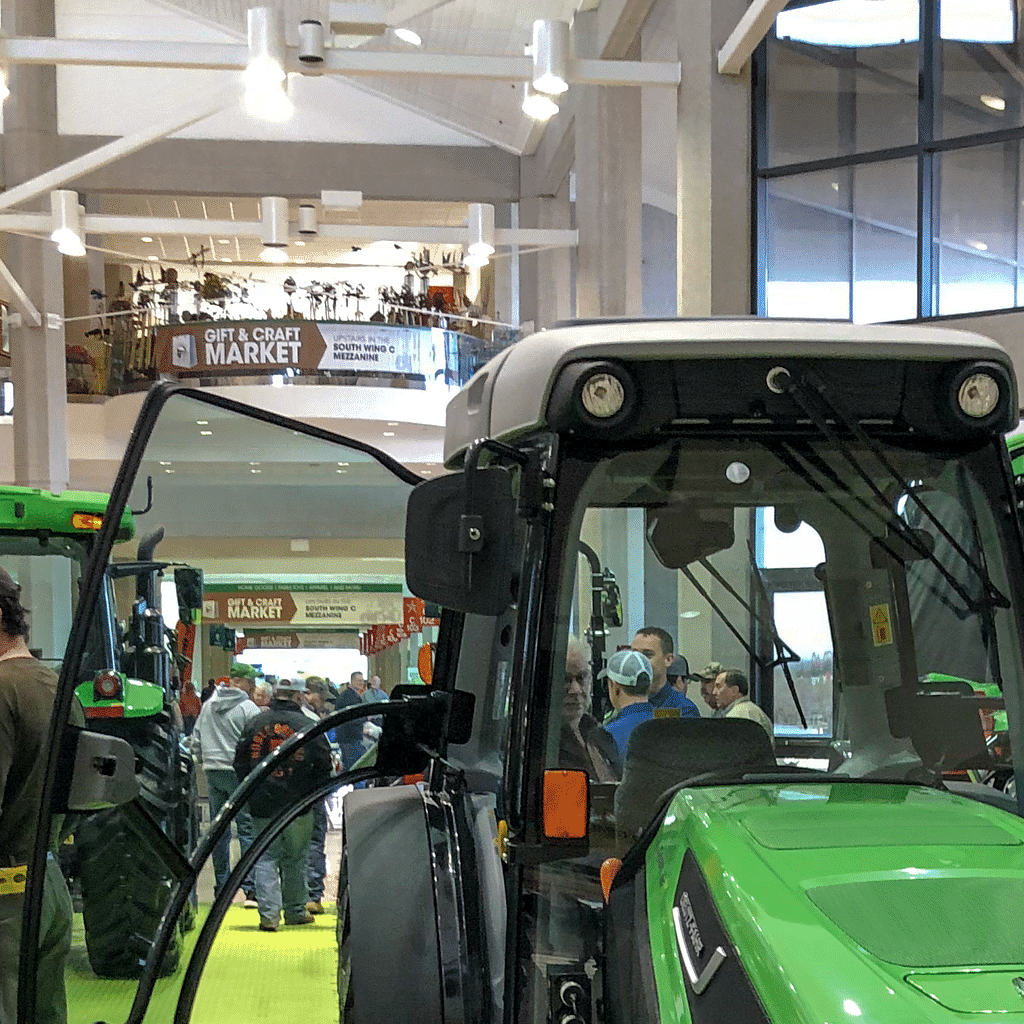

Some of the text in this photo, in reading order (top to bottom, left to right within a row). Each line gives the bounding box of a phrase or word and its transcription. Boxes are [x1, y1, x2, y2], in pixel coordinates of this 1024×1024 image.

[204, 327, 300, 343] GIFT & CRAFT
[205, 342, 301, 365] MARKET
[333, 343, 396, 354] SOUTH WING C
[333, 352, 379, 362] MEZZANINE
[227, 598, 246, 606] GIFT
[255, 598, 282, 606] CRAFT
[227, 606, 283, 619] MARKET
